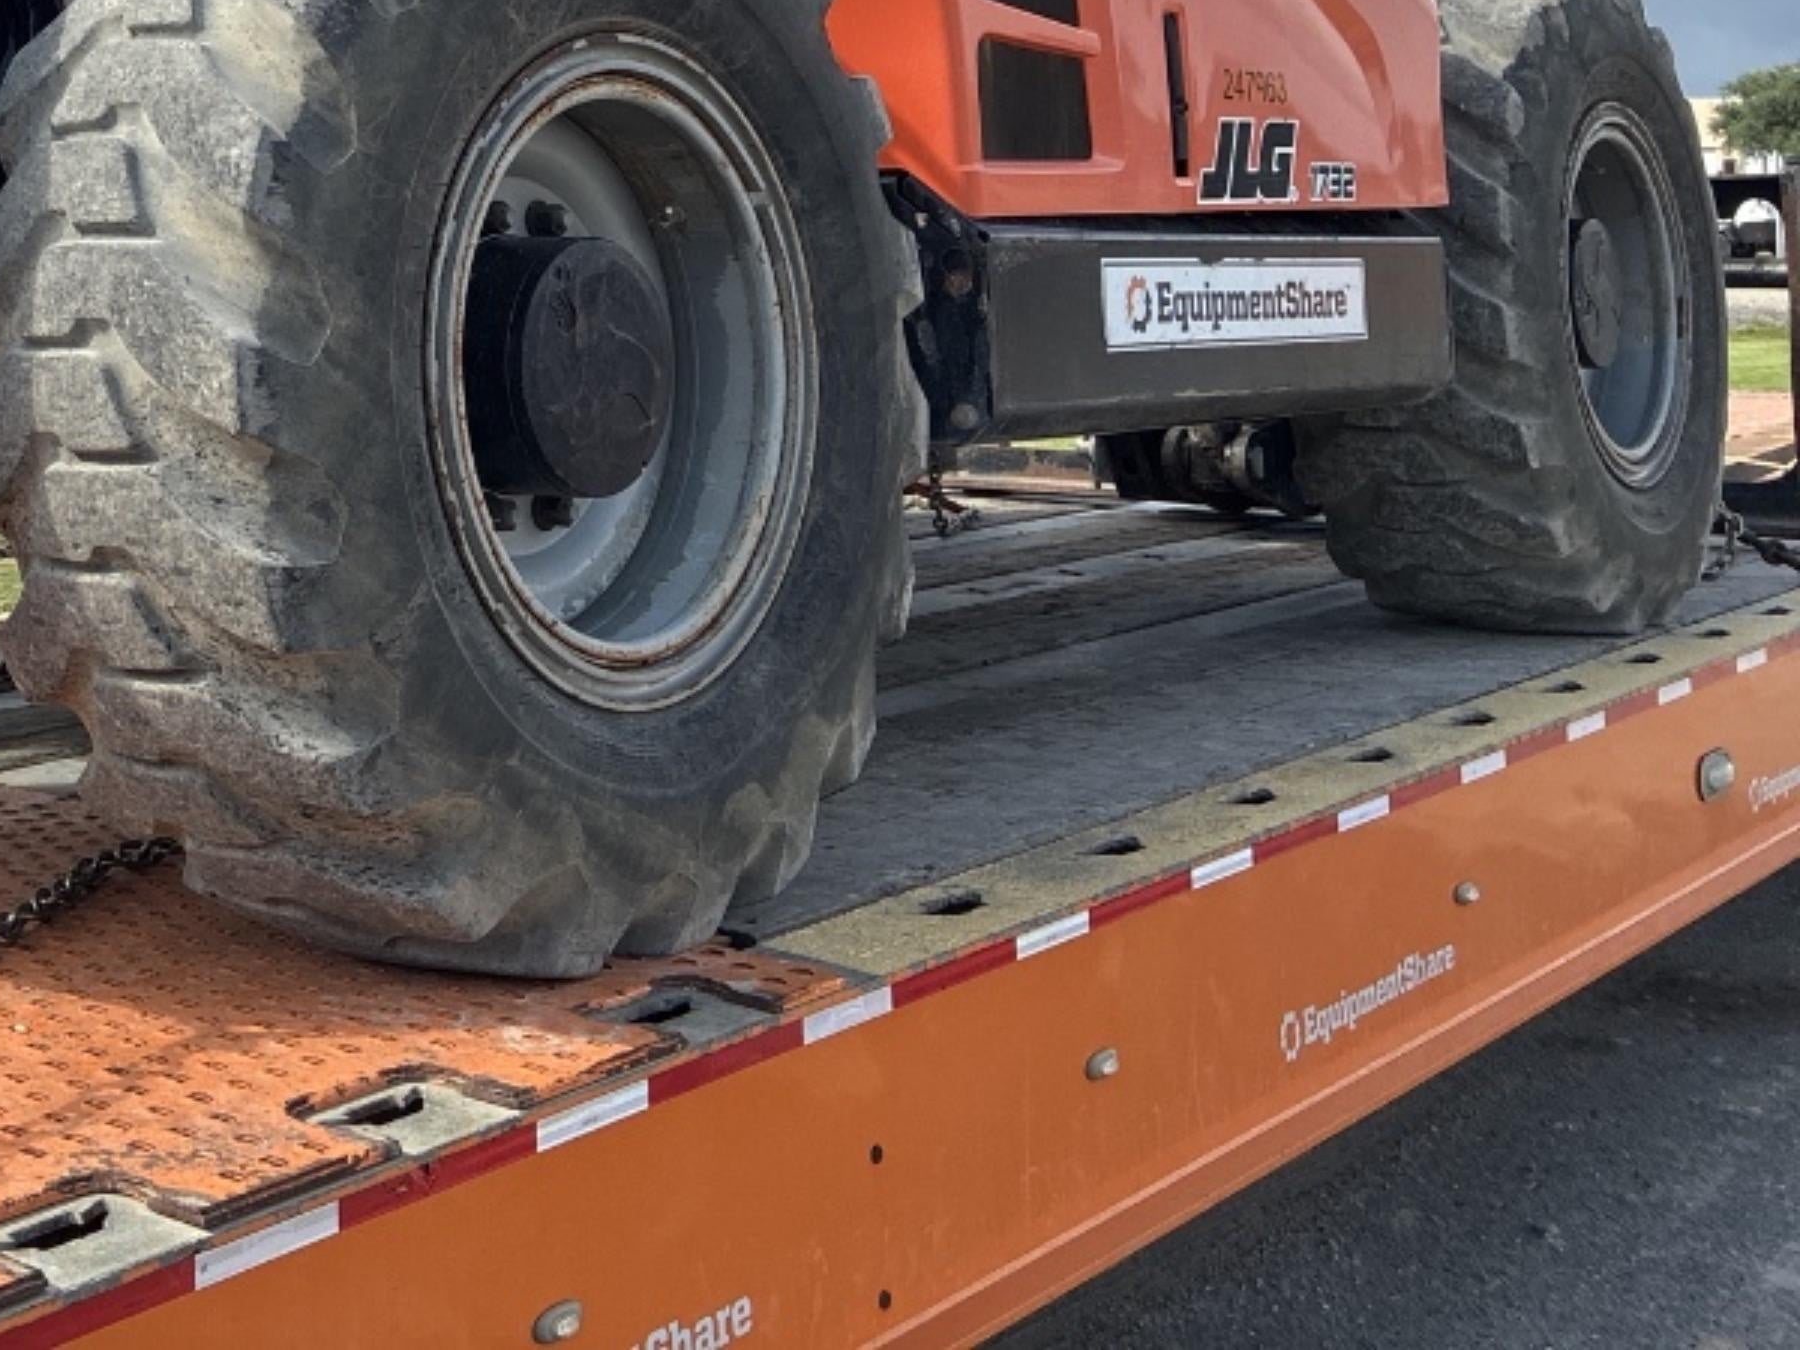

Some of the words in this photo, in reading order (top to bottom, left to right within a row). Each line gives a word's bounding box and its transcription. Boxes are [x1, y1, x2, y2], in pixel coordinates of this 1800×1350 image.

[1222, 68, 1288, 105] 247963
[1197, 116, 1300, 205] JLG
[1156, 281, 1348, 333] EquipmentShare
[1303, 944, 1456, 1045] EquipmentShare
